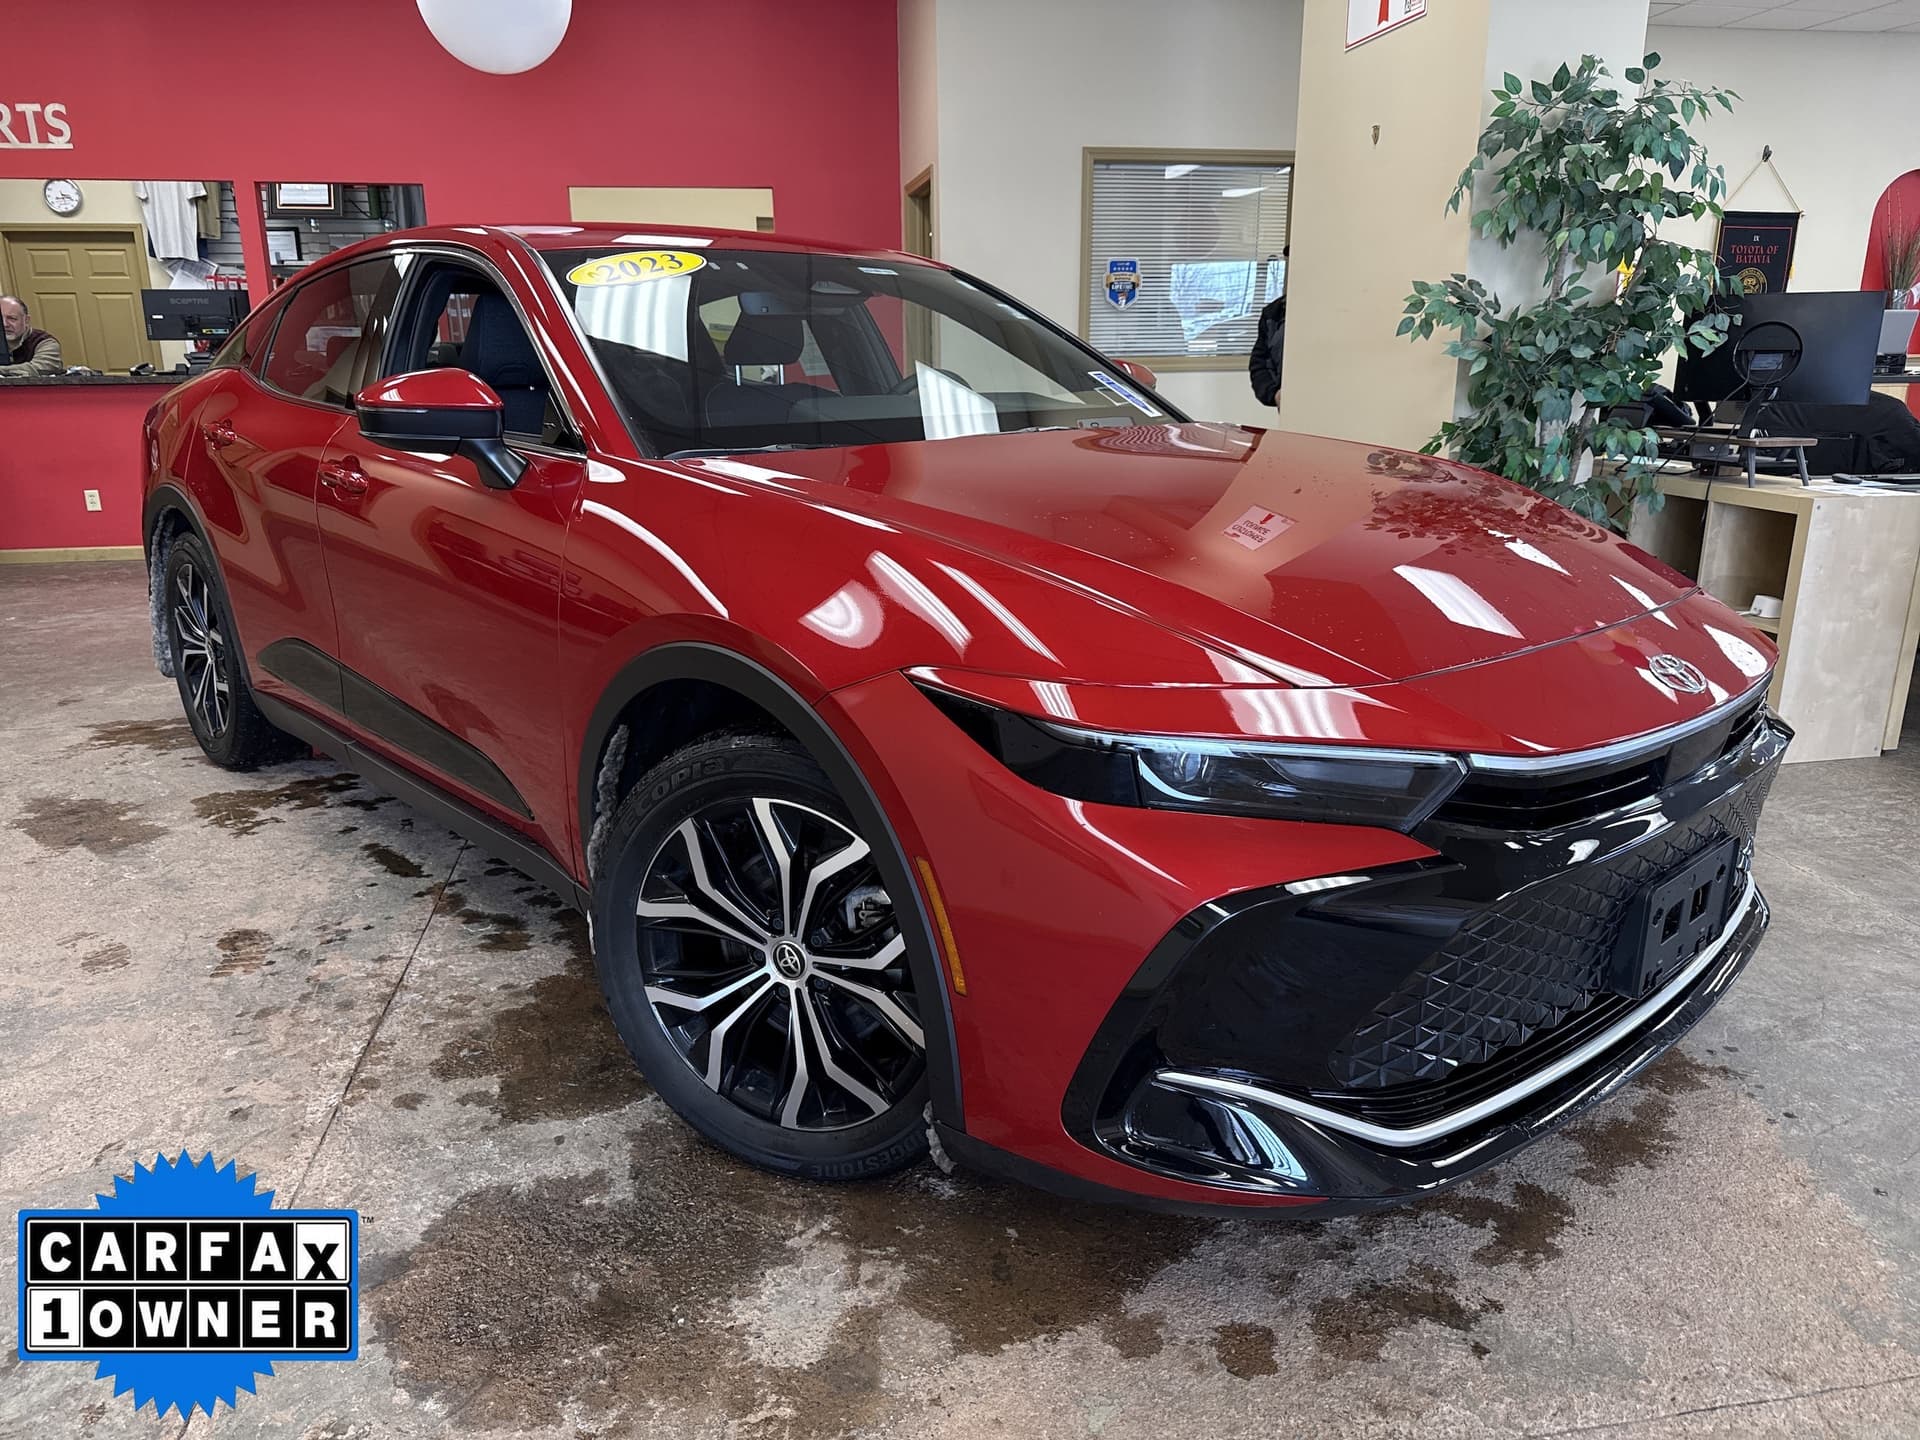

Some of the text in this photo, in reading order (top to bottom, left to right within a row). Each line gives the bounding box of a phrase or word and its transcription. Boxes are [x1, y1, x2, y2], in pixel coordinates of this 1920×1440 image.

[1730, 245, 1779, 255] TOYOTA OF
[1735, 255, 1771, 264] BATAVIA
[595, 253, 684, 283] 2023
[169, 297, 209, 305] SCEPTRE
